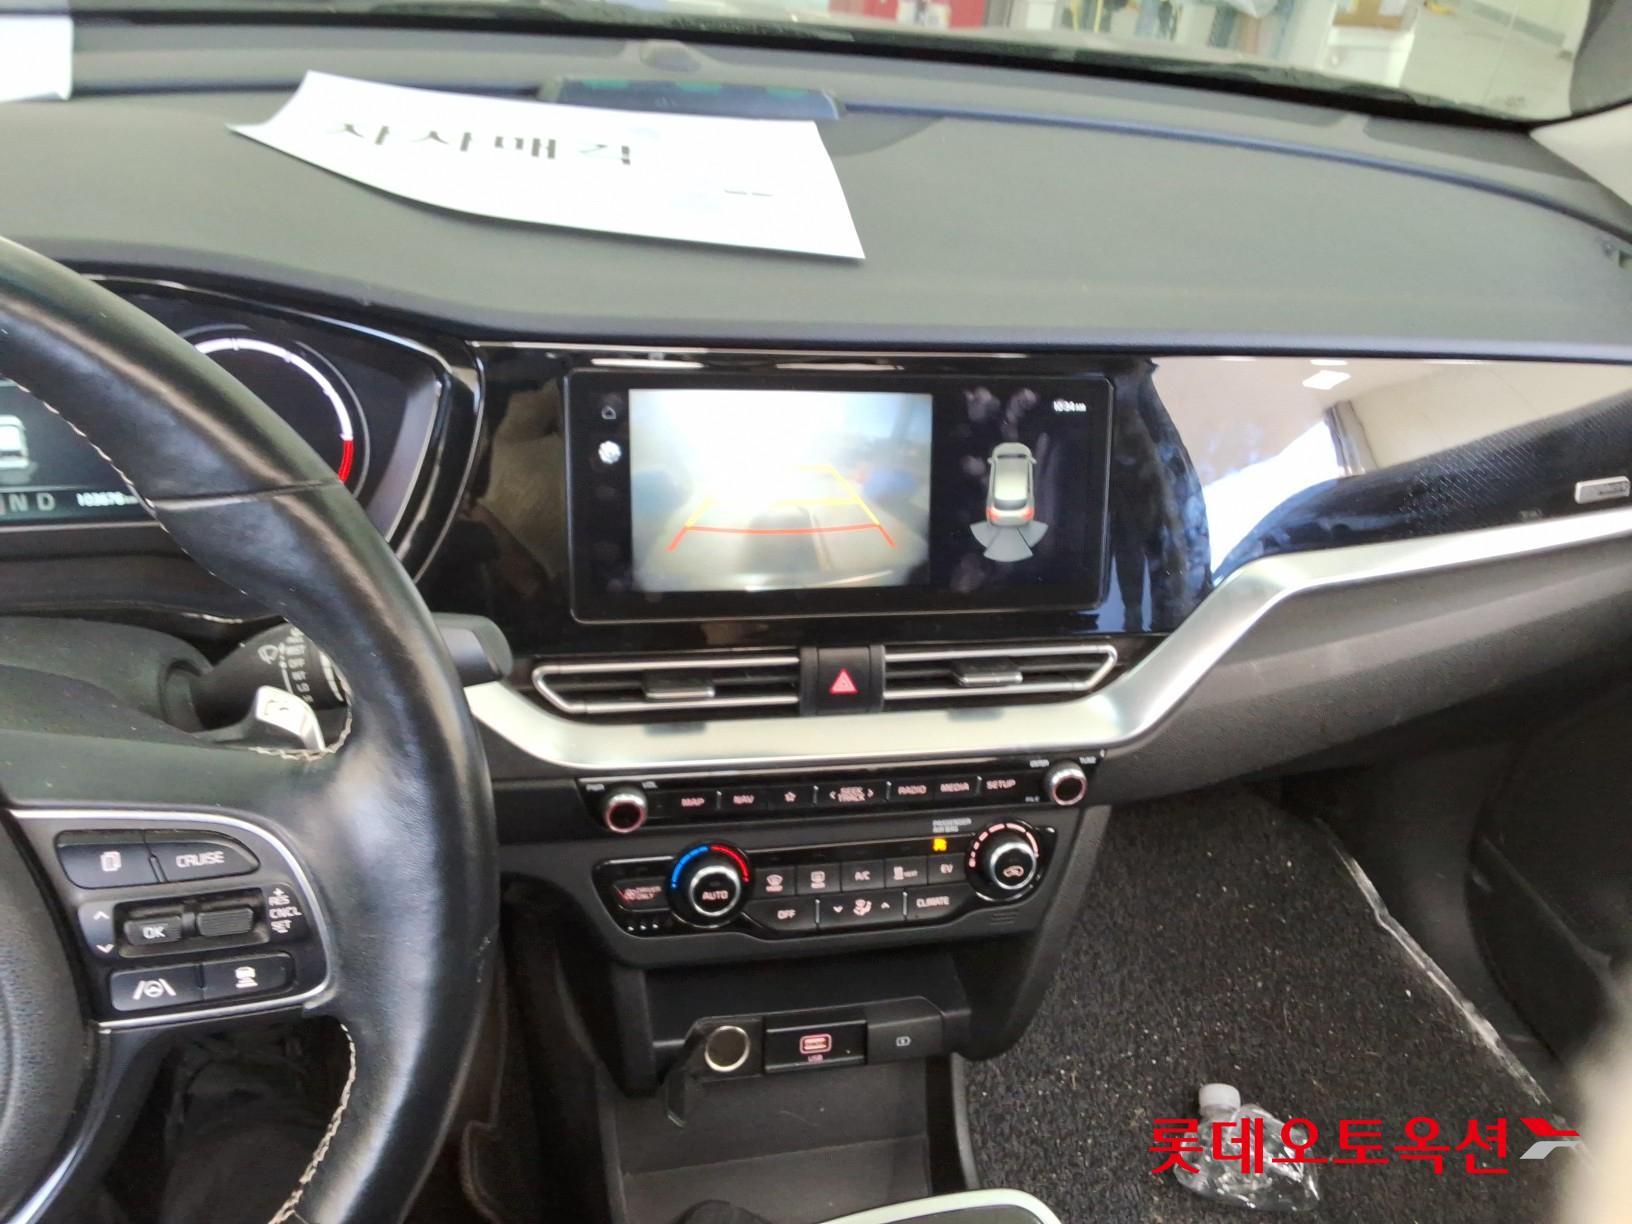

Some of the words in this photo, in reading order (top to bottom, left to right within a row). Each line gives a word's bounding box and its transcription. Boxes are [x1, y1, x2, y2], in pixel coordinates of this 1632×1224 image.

[37, 493, 56, 511] D
[898, 784, 927, 795] RADIO
[940, 782, 970, 793] MEDIA
[986, 779, 1016, 790] SETUP
[681, 797, 705, 807] MAP
[733, 795, 754, 804] NAV
[176, 850, 225, 868] CRUISE
[940, 863, 954, 874] EV
[702, 889, 729, 901] AUTO
[916, 896, 950, 908] CLIMATE
[777, 909, 796, 919] OFF
[143, 925, 166, 940] OK
